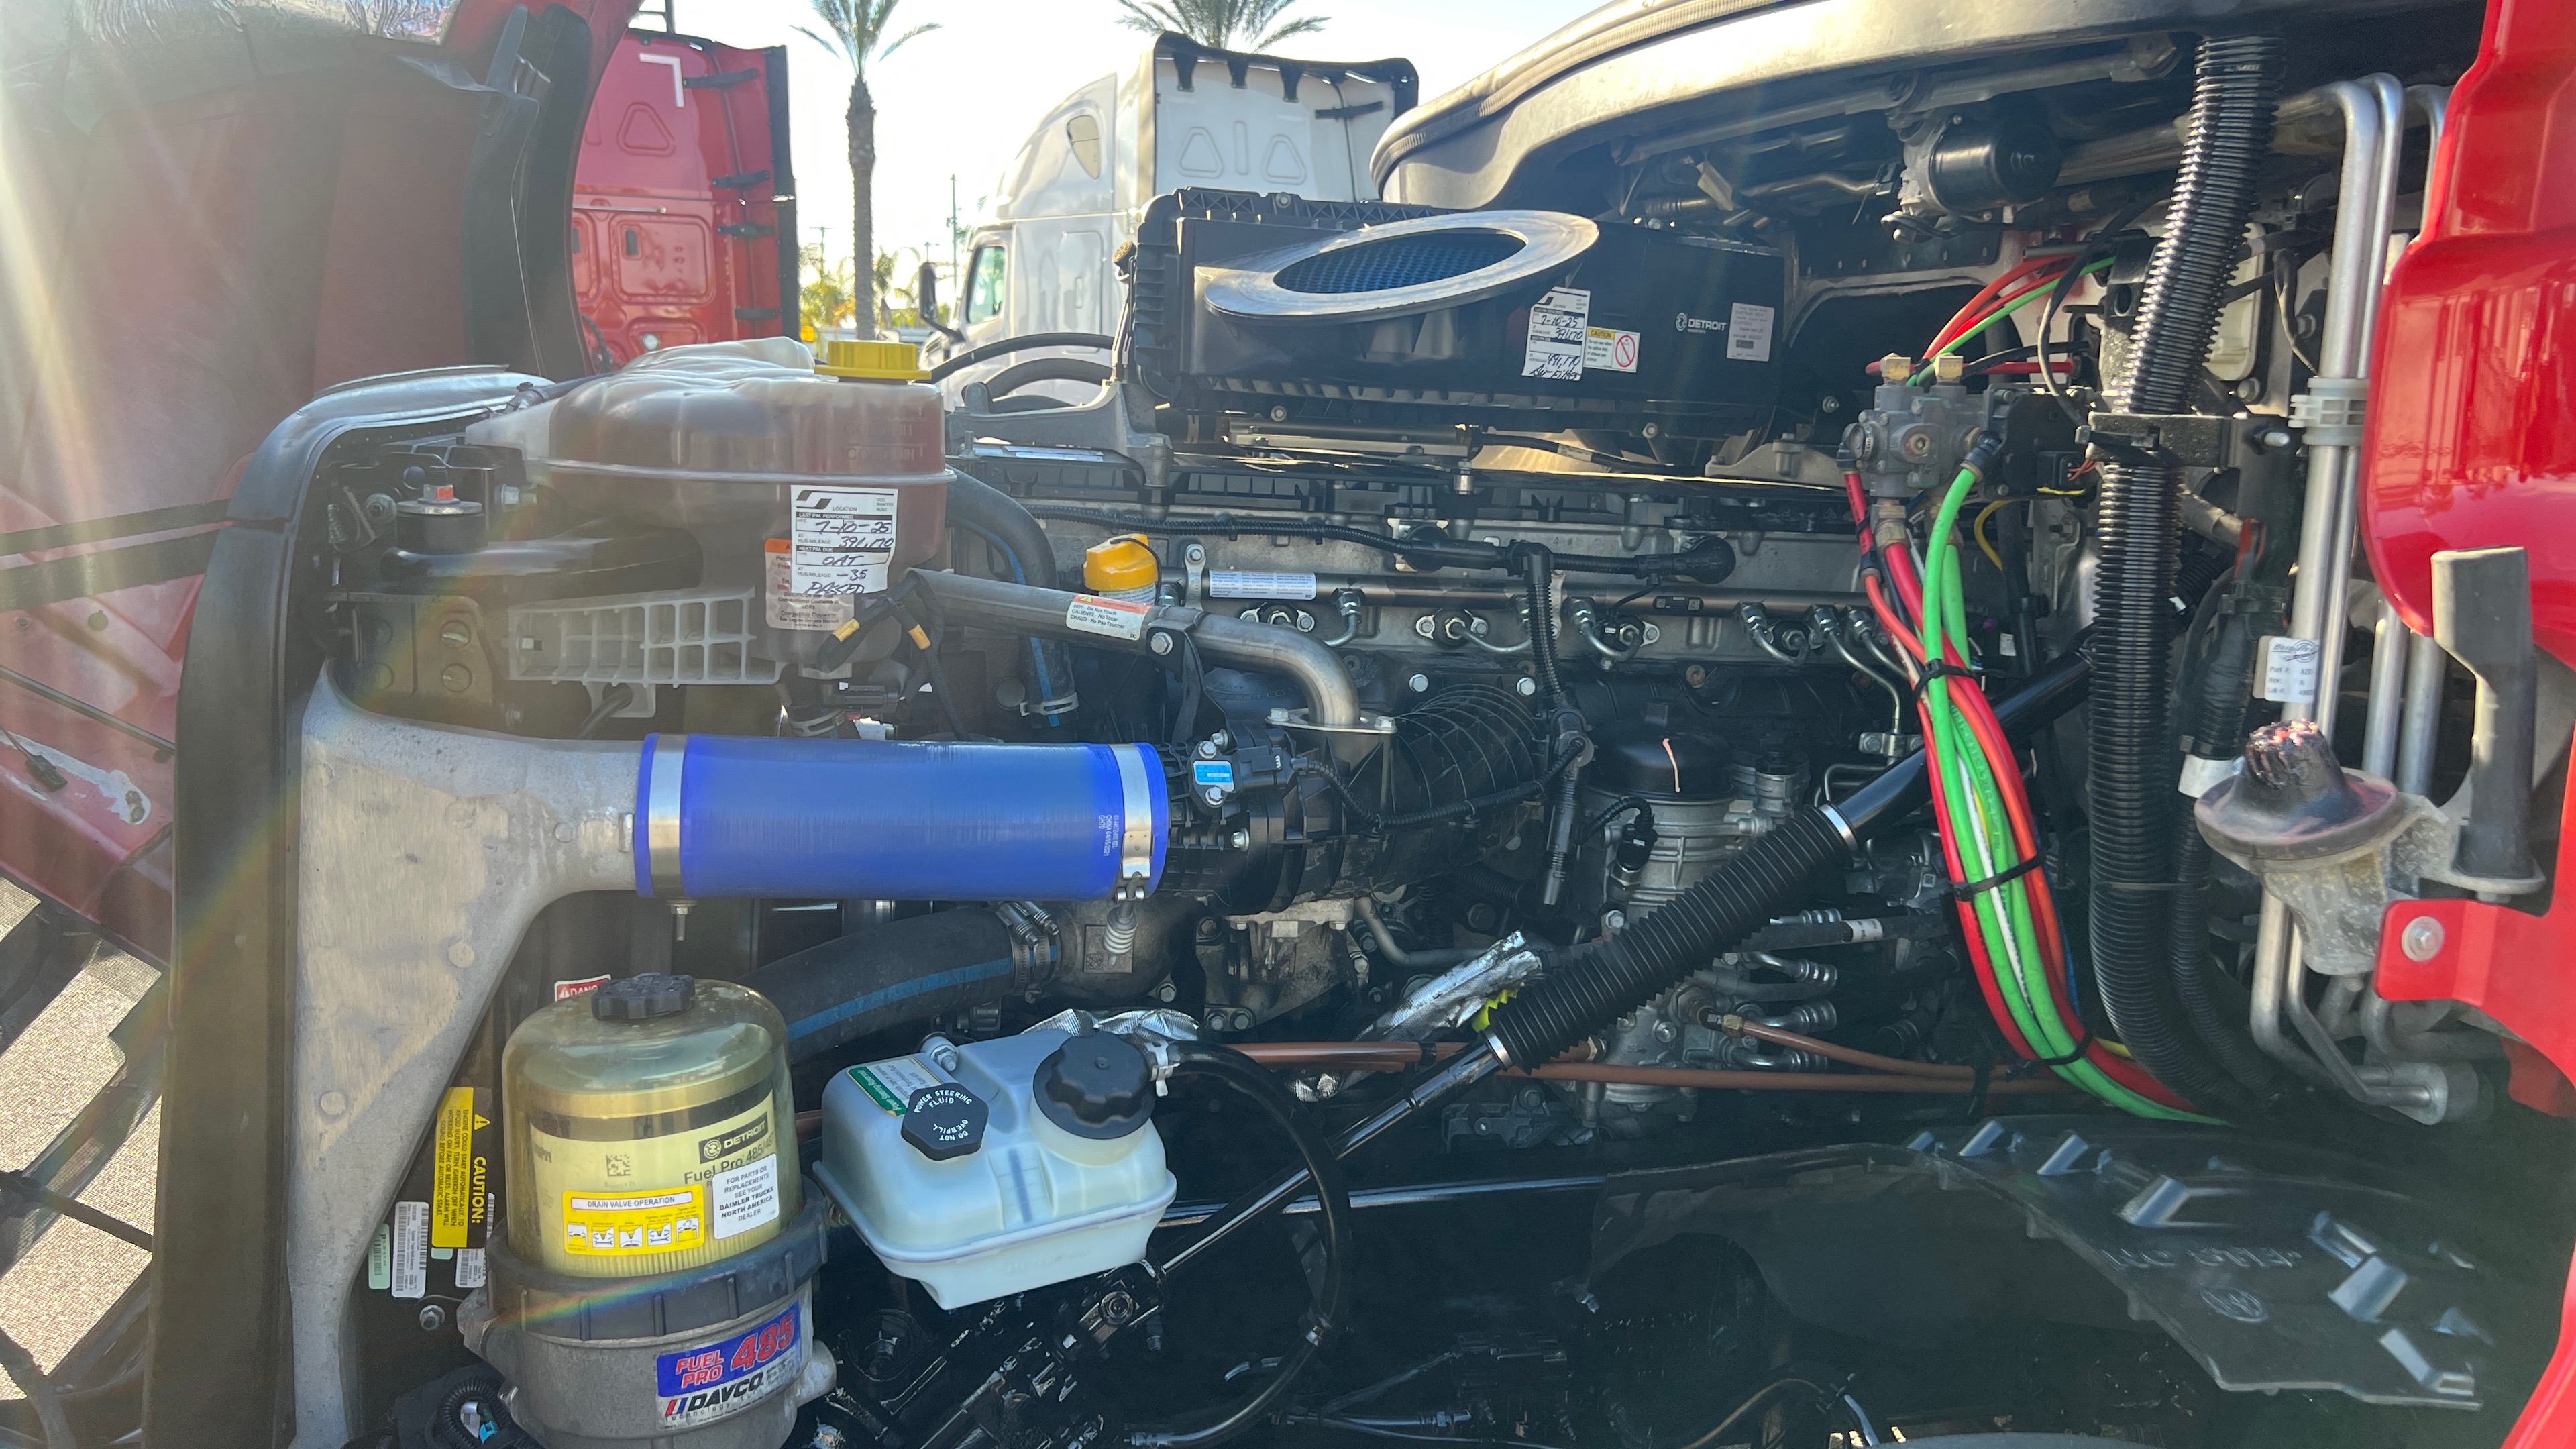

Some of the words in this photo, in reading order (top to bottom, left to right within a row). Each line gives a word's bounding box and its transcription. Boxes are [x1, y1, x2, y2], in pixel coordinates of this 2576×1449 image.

[1542, 315, 1578, 328] 7-10-25
[1688, 318, 1727, 331] DETROIT
[1590, 329, 1613, 339] CAUTION
[804, 581, 865, 595] PASSED
[1071, 609, 1095, 617] CALIENTE
[914, 1093, 933, 1114] POWER
[934, 1089, 973, 1105] STEERING
[928, 1097, 955, 1108] FLUID
[932, 1119, 969, 1134] OVERFILL
[724, 1120, 766, 1149] DETROIT
[958, 1130, 969, 1139] DO
[447, 1139, 453, 1149] ON
[446, 1163, 451, 1173] OR
[684, 1164, 716, 1185] Fuel
[721, 1157, 743, 1172] Pro
[727, 1175, 739, 1185] FOR
[741, 1169, 759, 1180] PARTS
[759, 1165, 767, 1174] OR
[437, 1165, 445, 1198] AUTOMATIC
[724, 1173, 769, 1193] REPLACEMENTS
[471, 1156, 487, 1224] CAUTION:
[735, 1189, 747, 1199] SEE
[748, 1183, 763, 1194] YOUR
[610, 1199, 632, 1208] VALVE
[634, 1197, 675, 1207] OPERATION
[719, 1195, 750, 1211] DAIMLER
[752, 1187, 774, 1199] TRUCKS
[721, 1205, 746, 1218] NORTH
[747, 1195, 773, 1210] AMERICA
[458, 1218, 464, 1226] TO
[738, 1209, 761, 1222] DEALER
[730, 1313, 795, 1371] 485
[676, 1350, 724, 1375] FUEL
[681, 1366, 723, 1389] PRO
